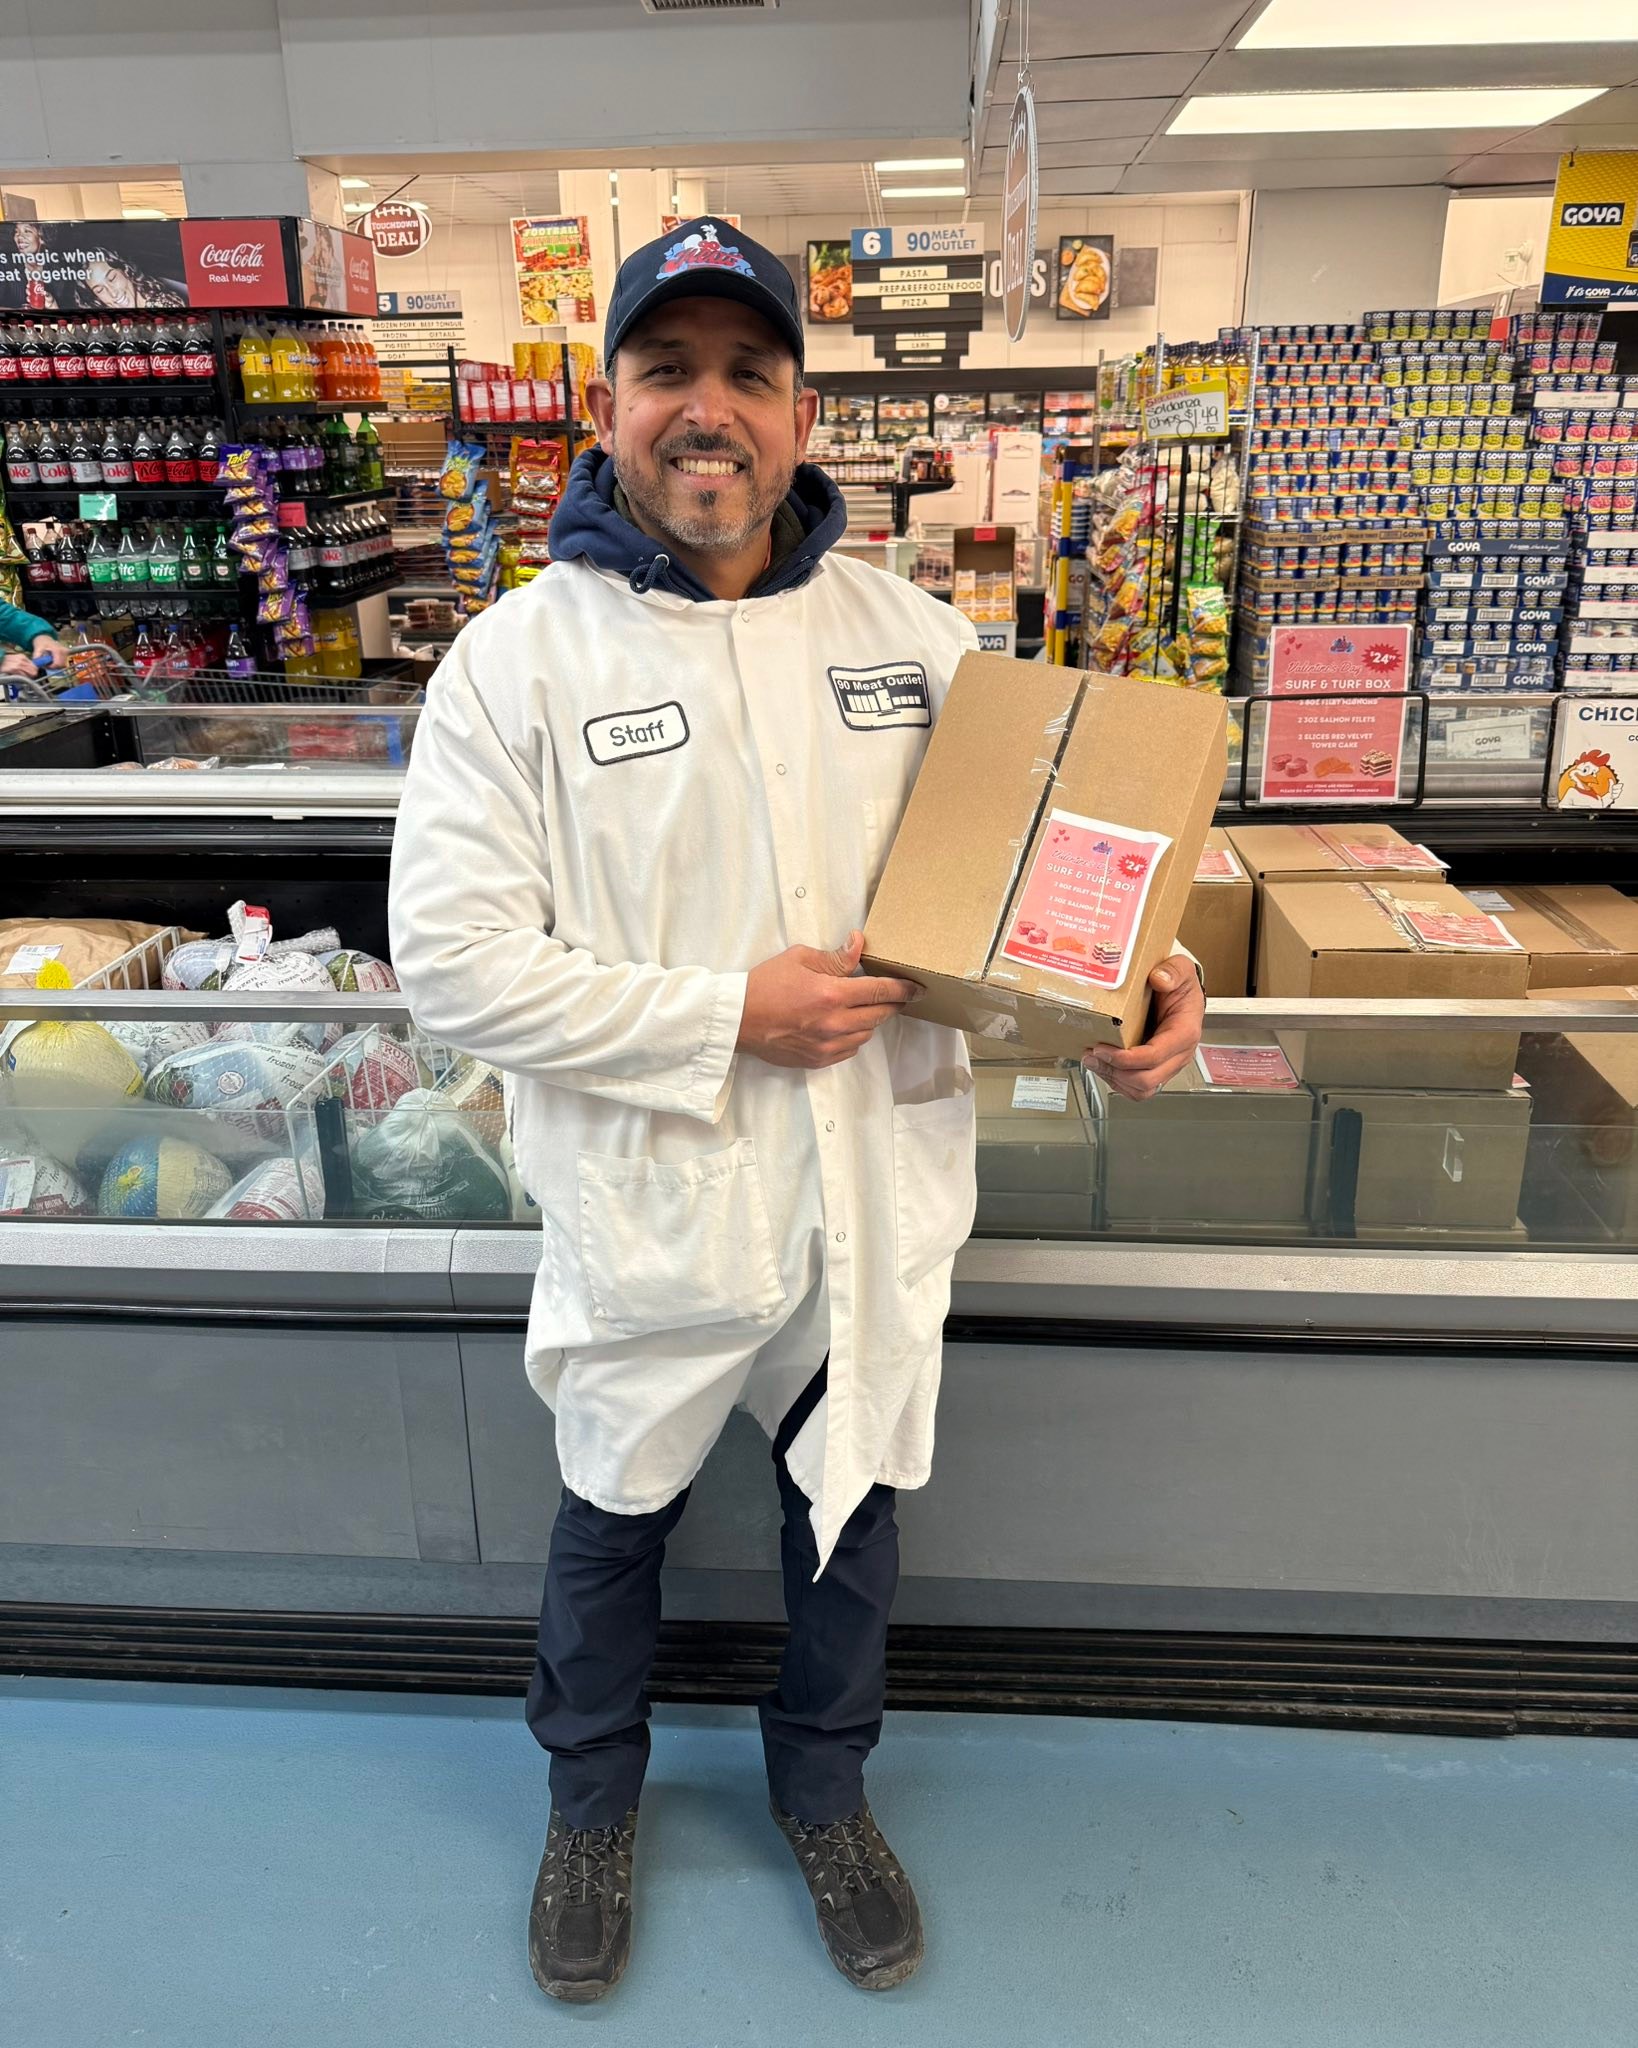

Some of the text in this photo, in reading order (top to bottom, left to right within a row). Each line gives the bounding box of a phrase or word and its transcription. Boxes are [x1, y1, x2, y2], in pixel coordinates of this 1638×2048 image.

[1564, 206, 1621, 225] GOYA
[371, 220, 418, 230] TOUCHDOWN
[375, 231, 419, 247] DEAL
[863, 231, 881, 255] 6
[907, 229, 965, 251] 90 MEAT
[932, 240, 976, 251] OUTLET
[12, 249, 60, 267] magic
[63, 247, 105, 263] when
[200, 242, 264, 269] Coca-Cola
[26, 265, 93, 284] together
[208, 274, 229, 283] Real
[900, 270, 928, 278] PASTA
[956, 282, 982, 290] FOOD
[1585, 288, 1611, 298] GOYA
[378, 294, 391, 312] 5
[407, 295, 423, 310] 90
[424, 302, 456, 310] OUTLET
[902, 299, 928, 307] PIZZA
[1447, 542, 1481, 552] GOYA
[1524, 576, 1556, 586] GOYA
[1519, 610, 1551, 620] GOYA
[1516, 643, 1547, 653] GOYA
[1340, 661, 1363, 676] Day
[837, 674, 922, 691] 90 Meat Outlet
[1285, 679, 1391, 689] SURF & TURF BOX
[1513, 675, 1544, 685] GOYA
[1579, 706, 1638, 722] CHIC
[609, 719, 664, 747] Staff
[1046, 863, 1074, 876] SURF
[1086, 873, 1112, 886] TURF
[1114, 880, 1137, 892] BOX
[1067, 900, 1094, 911] SALMON
[1055, 920, 1078, 930] TOWER
[1074, 916, 1087, 924] RED
[1088, 919, 1111, 931] VELVET
